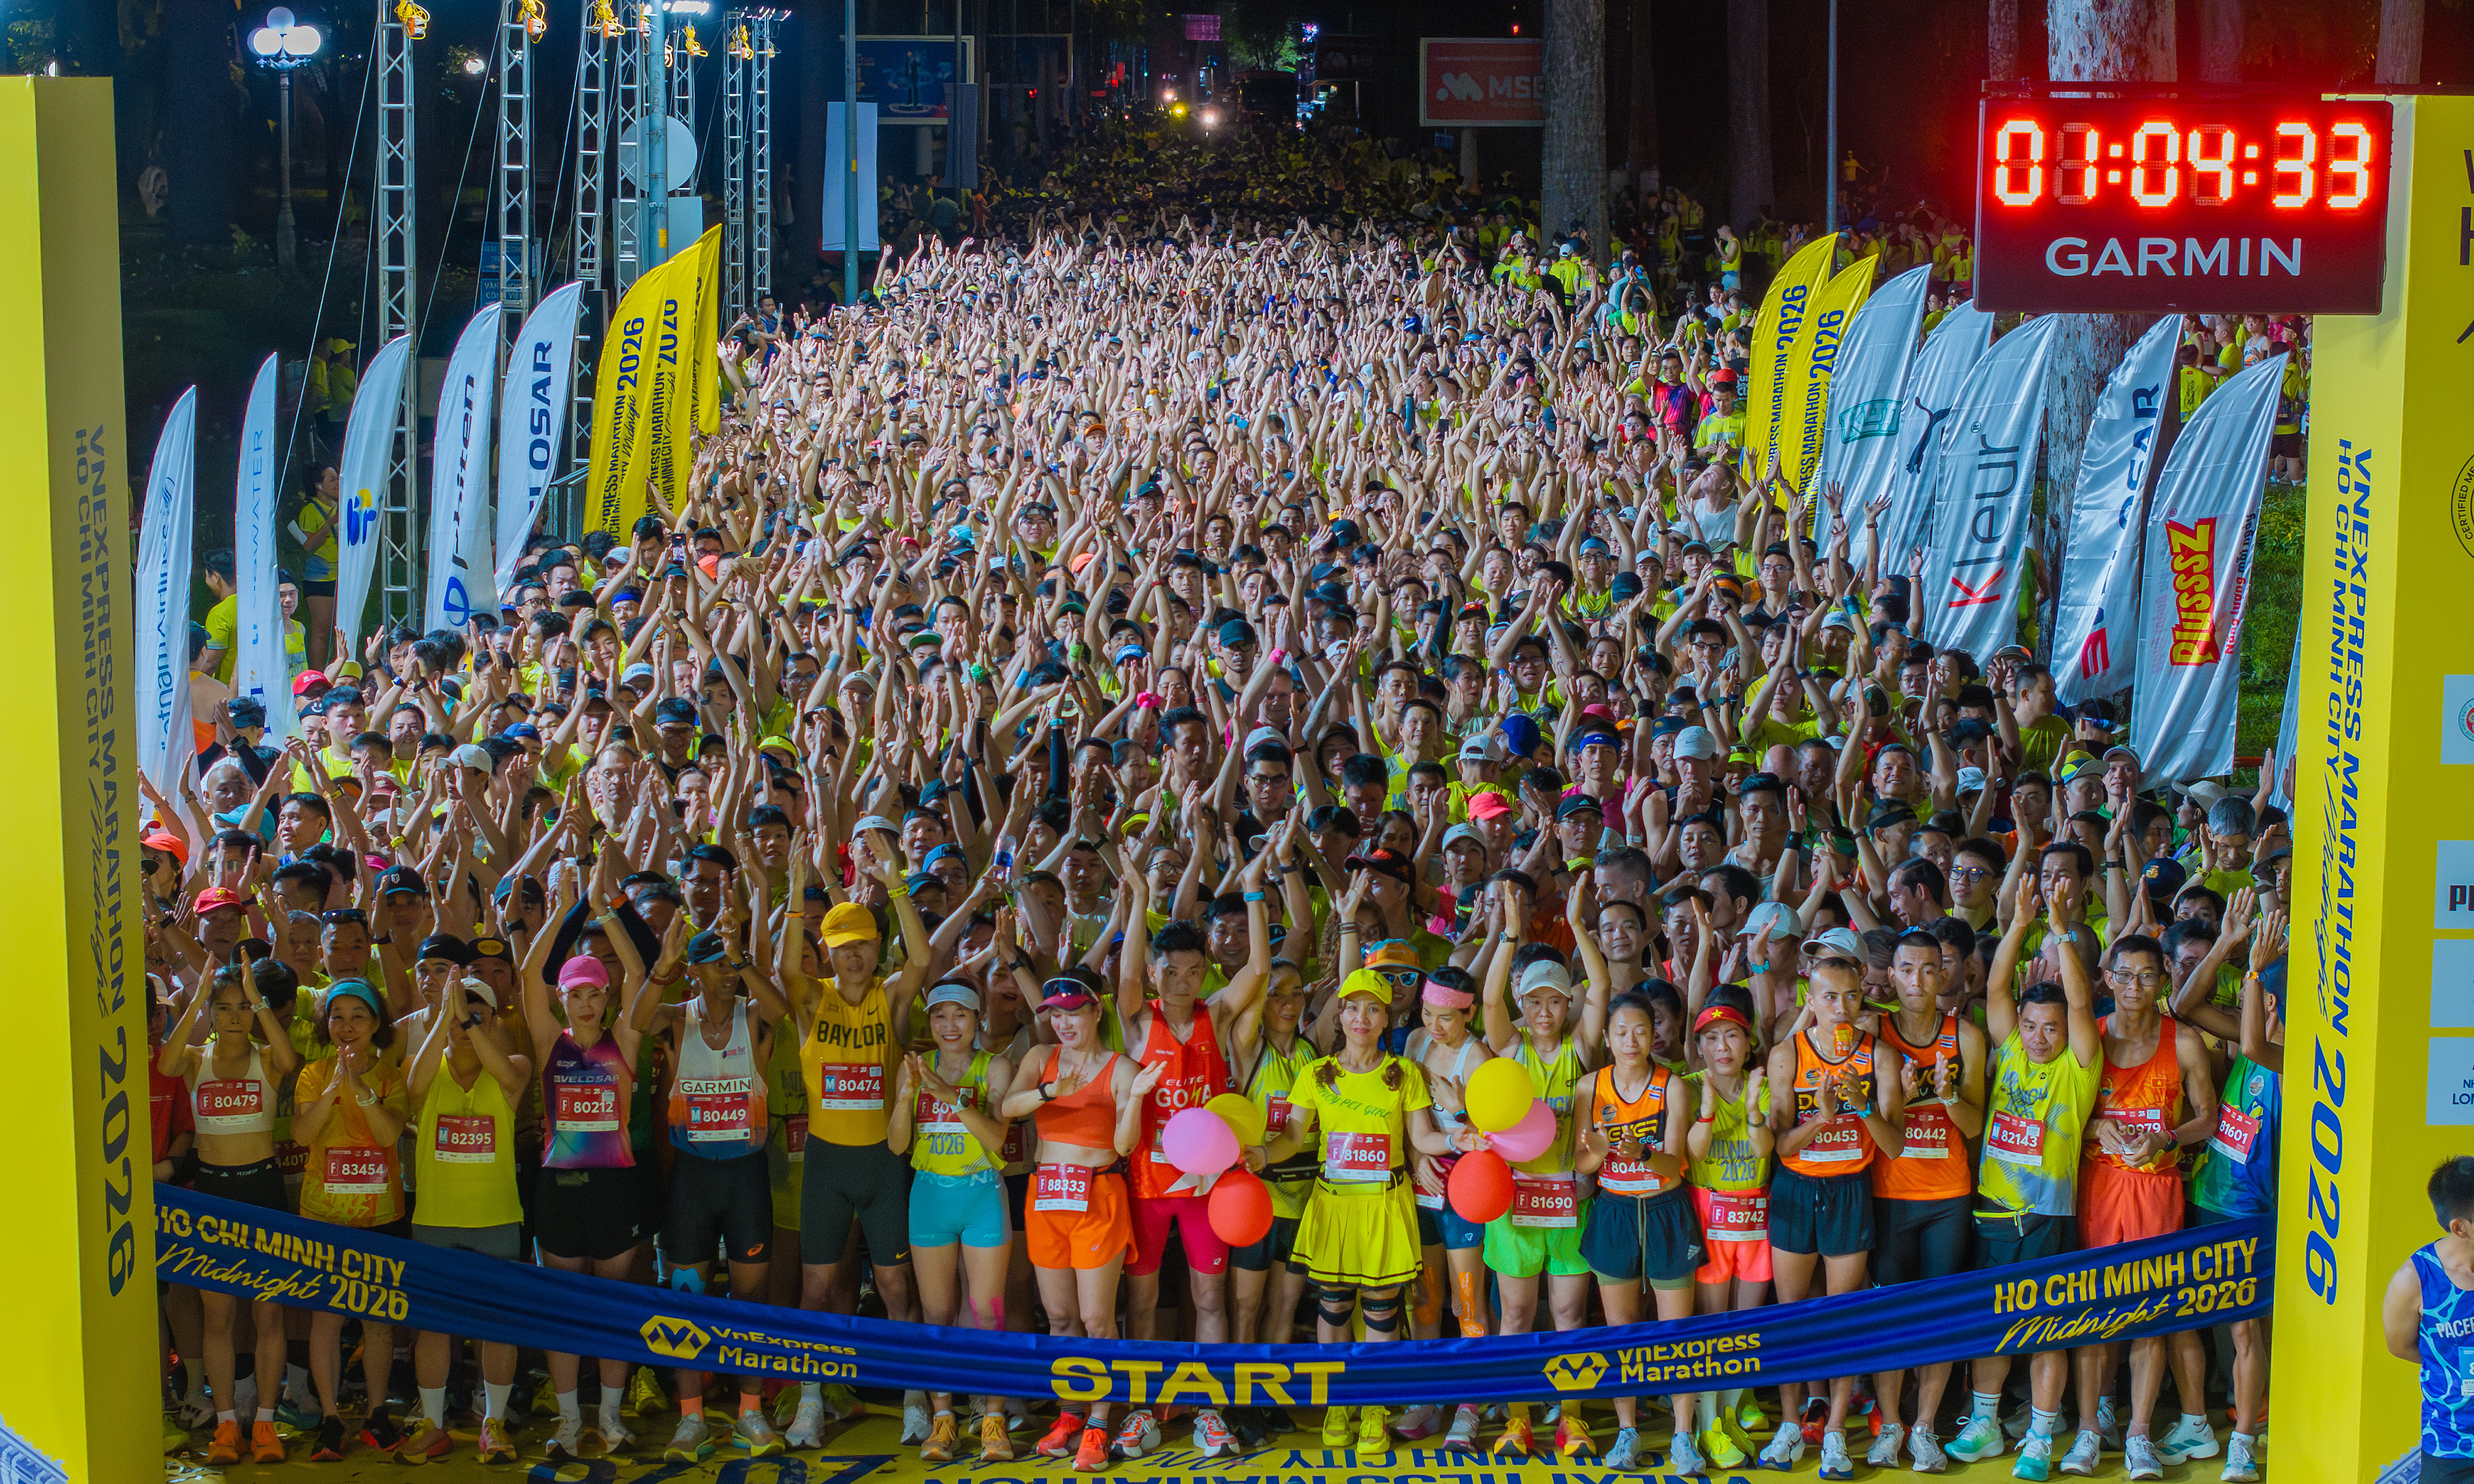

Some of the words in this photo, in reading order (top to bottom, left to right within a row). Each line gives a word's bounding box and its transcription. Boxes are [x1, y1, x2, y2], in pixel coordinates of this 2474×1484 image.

[1995, 120, 2371, 209] 01:04:33
[2045, 237, 2301, 277] GARMIN
[1776, 285, 1807, 350] 2026
[1809, 310, 1844, 378] 2026
[617, 317, 644, 391] 2026
[622, 395, 640, 458] Midnight
[1801, 382, 1820, 455] MARATHON
[76, 428, 87, 486] HO
[2337, 438, 2351, 495] HO
[78, 495, 92, 564] CHI
[1949, 434, 2019, 608] Kleur
[2334, 504, 2349, 570] CHI
[2458, 484, 2473, 540] CERTIFIED
[90, 424, 115, 720] VNEXPRESS
[2344, 448, 2372, 743] VNEXPRESS
[81, 572, 97, 680] MINH
[2330, 578, 2347, 683] MINH
[85, 689, 101, 770] CITY
[2325, 692, 2341, 778] CITY
[89, 776, 109, 1019] Midnight
[101, 727, 126, 1015] MARATHON
[2314, 776, 2337, 1022] Midnight
[2332, 752, 2359, 1037] MARATHON
[817, 1021, 887, 1049] BAYLOR
[215, 1094, 258, 1108] 80479
[573, 1101, 614, 1113] 80212
[681, 1079, 751, 1093] GARMIN
[838, 1079, 881, 1092] 80474
[1166, 1075, 1205, 1087] ELITE
[451, 1132, 492, 1145] 82395
[703, 1108, 746, 1123] 80449
[1815, 1129, 1858, 1143] 80453
[1905, 1127, 1946, 1140] 80442
[2001, 1129, 2037, 1148] 82143
[2219, 1119, 2248, 1145] 81601
[99, 1025, 135, 1298] 2026
[342, 1162, 385, 1175] 83454
[1344, 1149, 1385, 1162] 81860
[2305, 1033, 2346, 1306] 2026
[1048, 1178, 1086, 1192] 88333
[1531, 1196, 1572, 1209] 81690
[1727, 1210, 1764, 1223] 83742
[196, 1214, 250, 1250] CHI
[254, 1227, 334, 1273] MINH
[341, 1249, 406, 1287] CITY
[1994, 1279, 2037, 1314] HO
[2044, 1268, 2097, 1306] CHI
[2103, 1251, 2184, 1298] MINH
[2192, 1237, 2258, 1282] CITY
[156, 1243, 323, 1301] Midnight
[328, 1274, 409, 1321] 2026
[711, 1325, 857, 1356] VnExpress
[1994, 1293, 2171, 1352] Midnight
[2175, 1277, 2258, 1317] 2026
[719, 1345, 857, 1378] Marathon
[1617, 1332, 1761, 1364] VnExpress
[1621, 1356, 1761, 1384] Marathon
[1051, 1356, 1345, 1405] START
[1280, 1448, 1398, 1469] CITY
